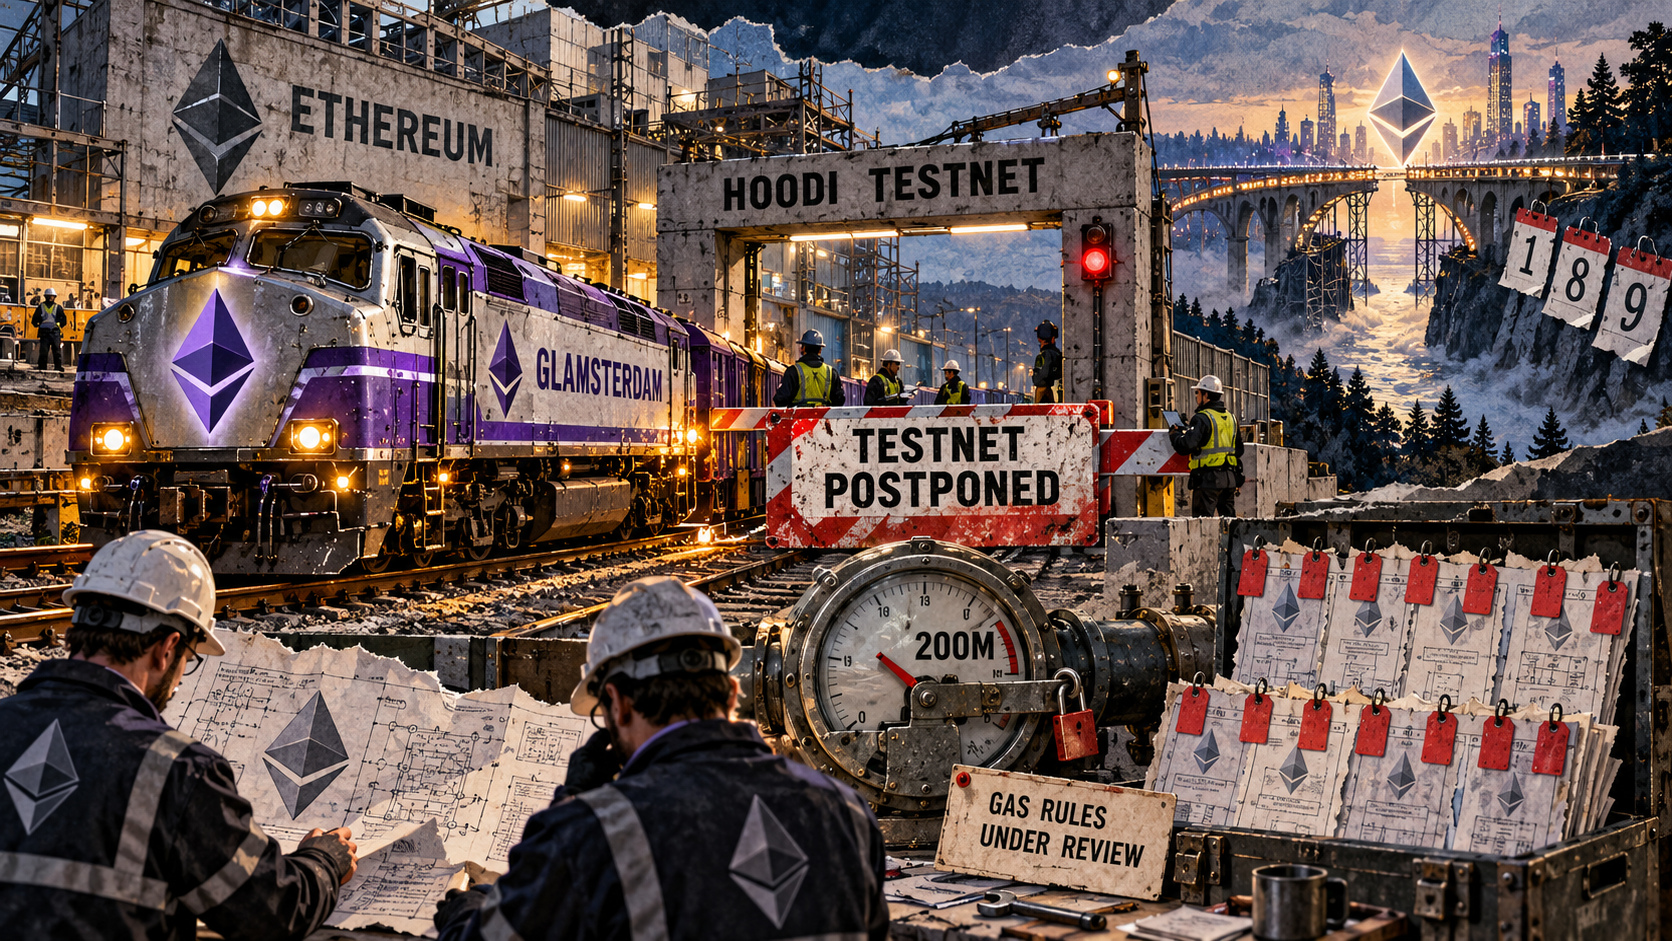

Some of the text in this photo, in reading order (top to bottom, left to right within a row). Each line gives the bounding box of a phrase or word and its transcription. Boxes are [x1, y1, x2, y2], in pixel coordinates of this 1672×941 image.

[291, 84, 493, 167] ETHEREUM
[723, 157, 1045, 211] HOODI TESTNET
[1519, 235, 1537, 276] 1
[1565, 257, 1590, 302] 8
[1620, 282, 1647, 332] 9
[536, 347, 662, 402] GLAMSTERDAM
[852, 426, 1025, 463] TESTNET
[825, 470, 1060, 509] POSTPONED
[915, 631, 994, 660] 200M
[989, 791, 1107, 829] GAS RULES
[980, 823, 1145, 868] UNDER REVIEW
